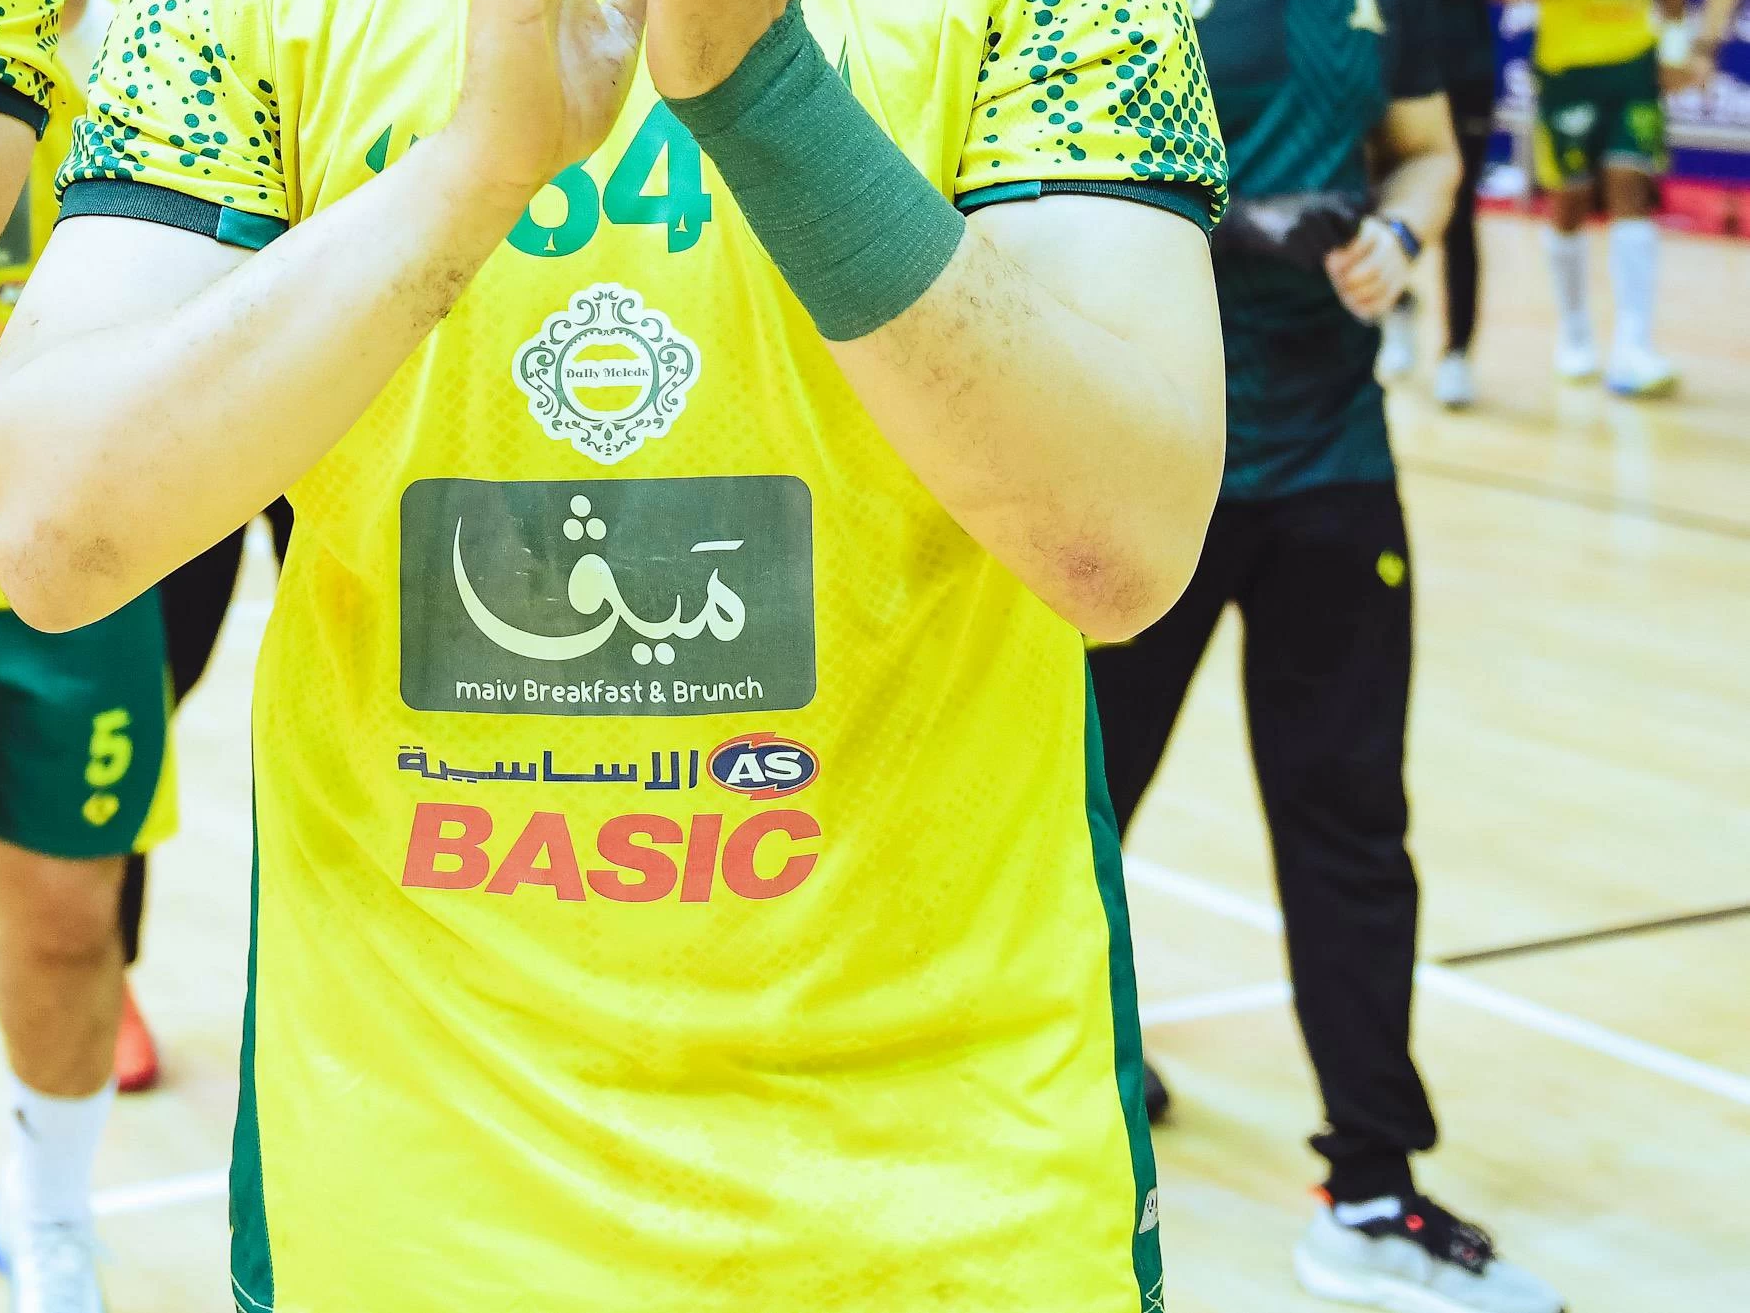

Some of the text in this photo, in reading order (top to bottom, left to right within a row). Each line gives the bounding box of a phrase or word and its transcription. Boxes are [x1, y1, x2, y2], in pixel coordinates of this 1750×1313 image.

[455, 676, 764, 704] maiv Breakfast & Brunch
[84, 707, 134, 787] 5
[724, 749, 802, 785] AS
[401, 802, 822, 903] BASIC
